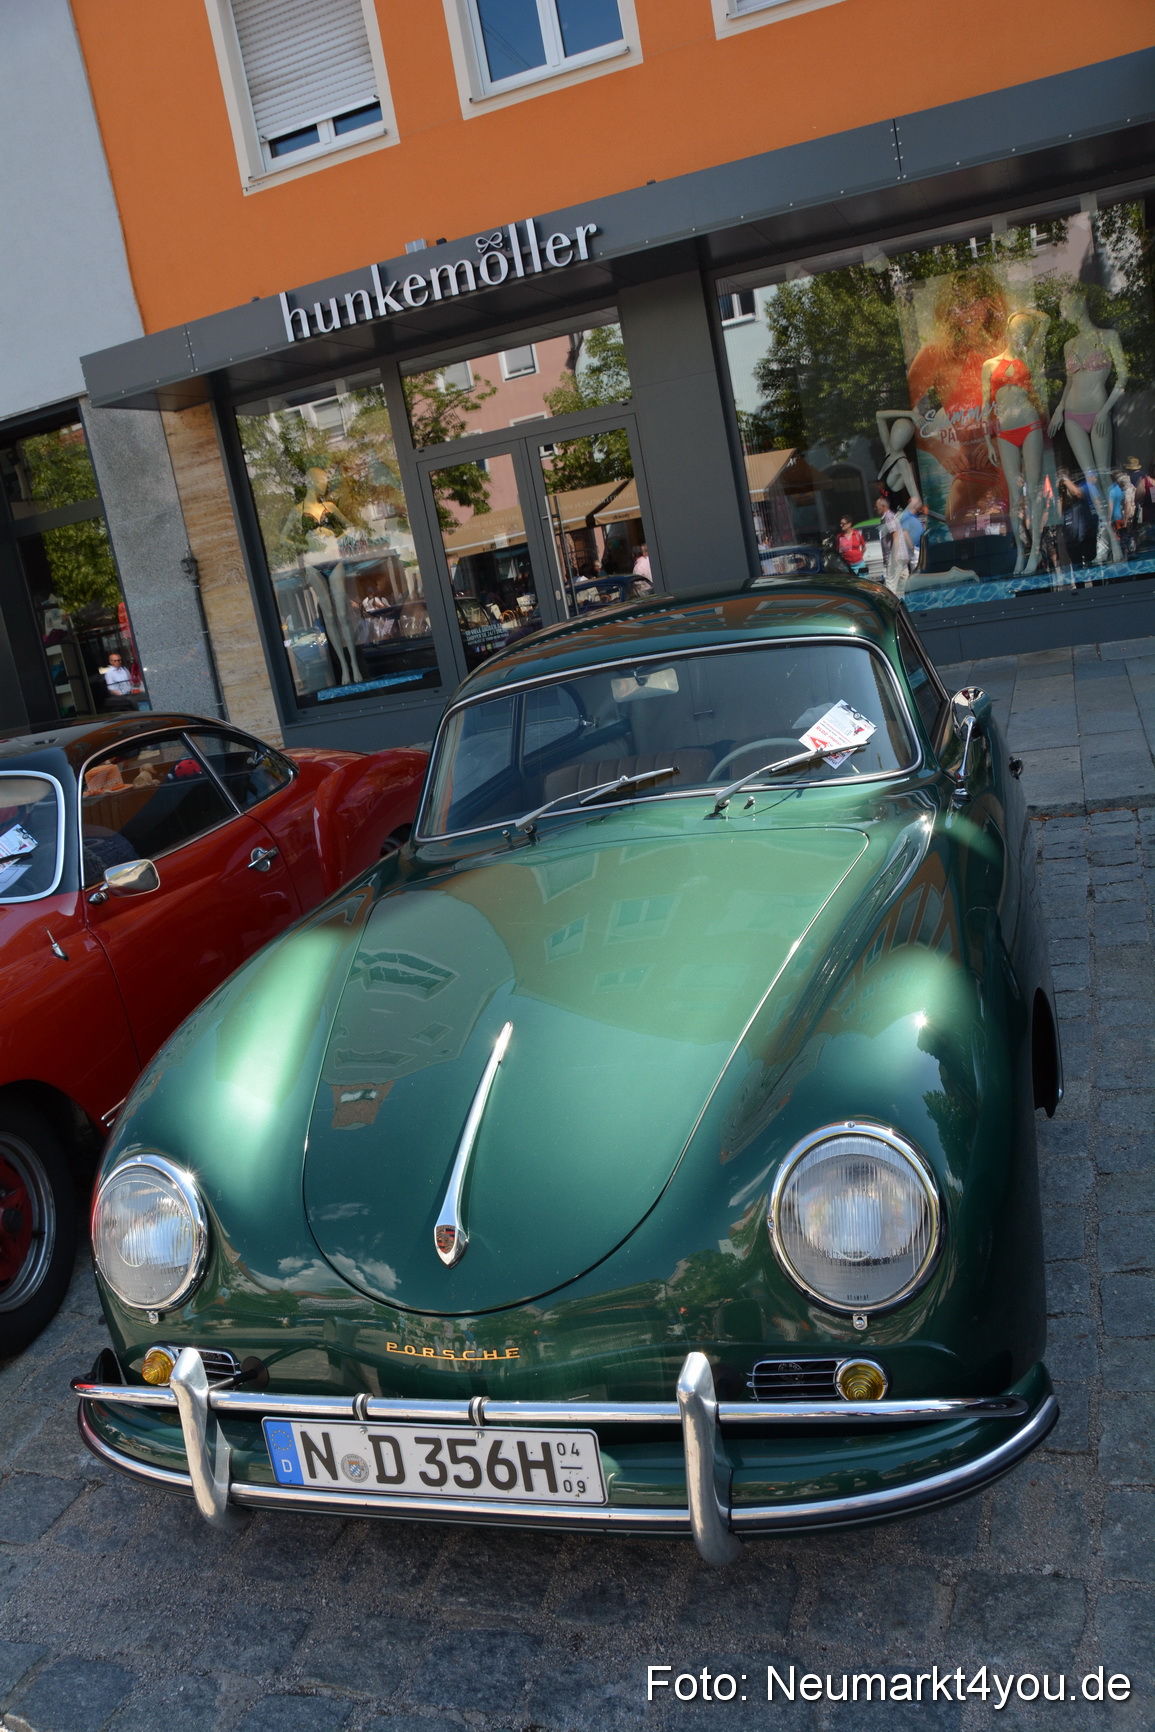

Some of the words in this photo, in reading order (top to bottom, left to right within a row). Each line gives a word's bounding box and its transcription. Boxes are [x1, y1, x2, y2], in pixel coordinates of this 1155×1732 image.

[386, 1341, 521, 1361] PORSCHE
[556, 1442, 580, 1457] 04
[281, 1458, 293, 1473] D
[563, 1479, 587, 1494] 09
